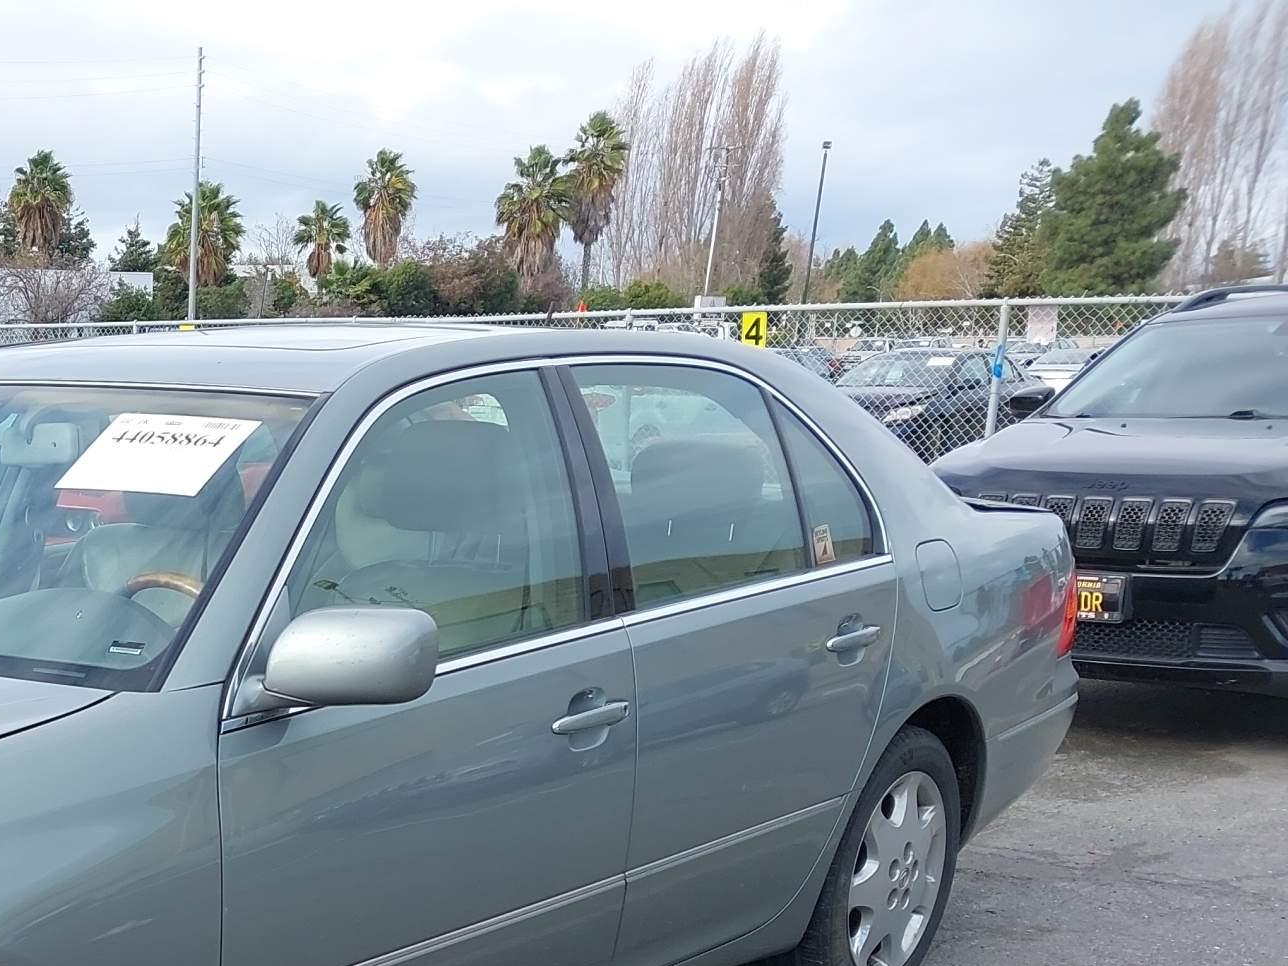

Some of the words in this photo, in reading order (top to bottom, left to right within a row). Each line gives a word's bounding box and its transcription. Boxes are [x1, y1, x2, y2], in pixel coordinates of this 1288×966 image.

[744, 316, 763, 346] 4
[111, 430, 227, 448] 44058864
[1082, 479, 1129, 491] Jeep
[1079, 591, 1103, 612] DR
